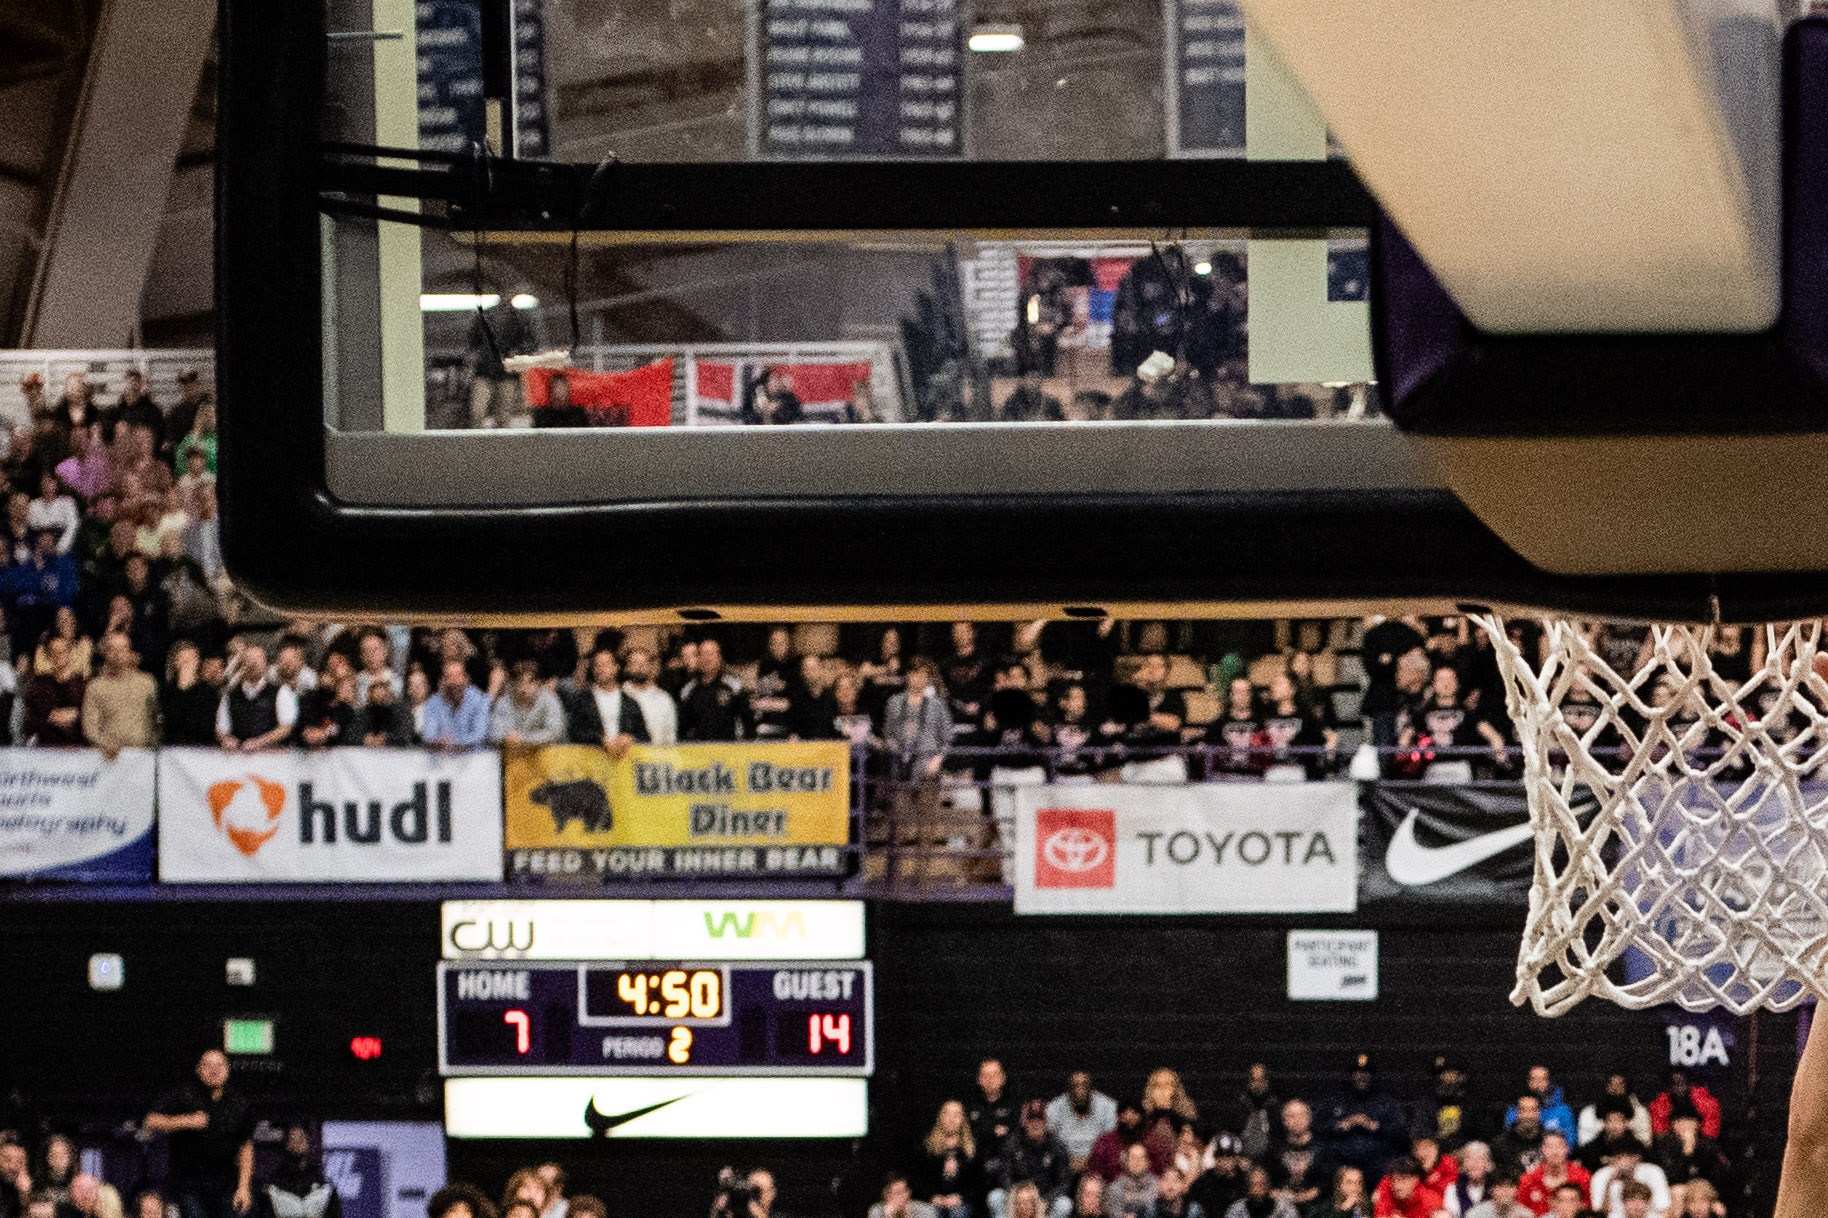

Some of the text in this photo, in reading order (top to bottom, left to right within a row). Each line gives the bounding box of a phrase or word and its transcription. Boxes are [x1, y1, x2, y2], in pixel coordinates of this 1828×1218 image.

[635, 761, 834, 795] Black Bear
[299, 781, 451, 845] hudl
[690, 803, 787, 837] Diner
[513, 848, 839, 872] FEED YOUR INNER BEAR
[1136, 830, 1336, 866] TOYOTA
[703, 911, 807, 939] WM
[457, 971, 531, 1001] HOME
[618, 970, 720, 1019] 4:50
[773, 971, 857, 1001] GUEST
[504, 1009, 530, 1054] 7
[602, 1024, 693, 1064] PERIOD 2
[808, 1013, 851, 1055] 14
[1665, 1025, 1730, 1067] 18A
